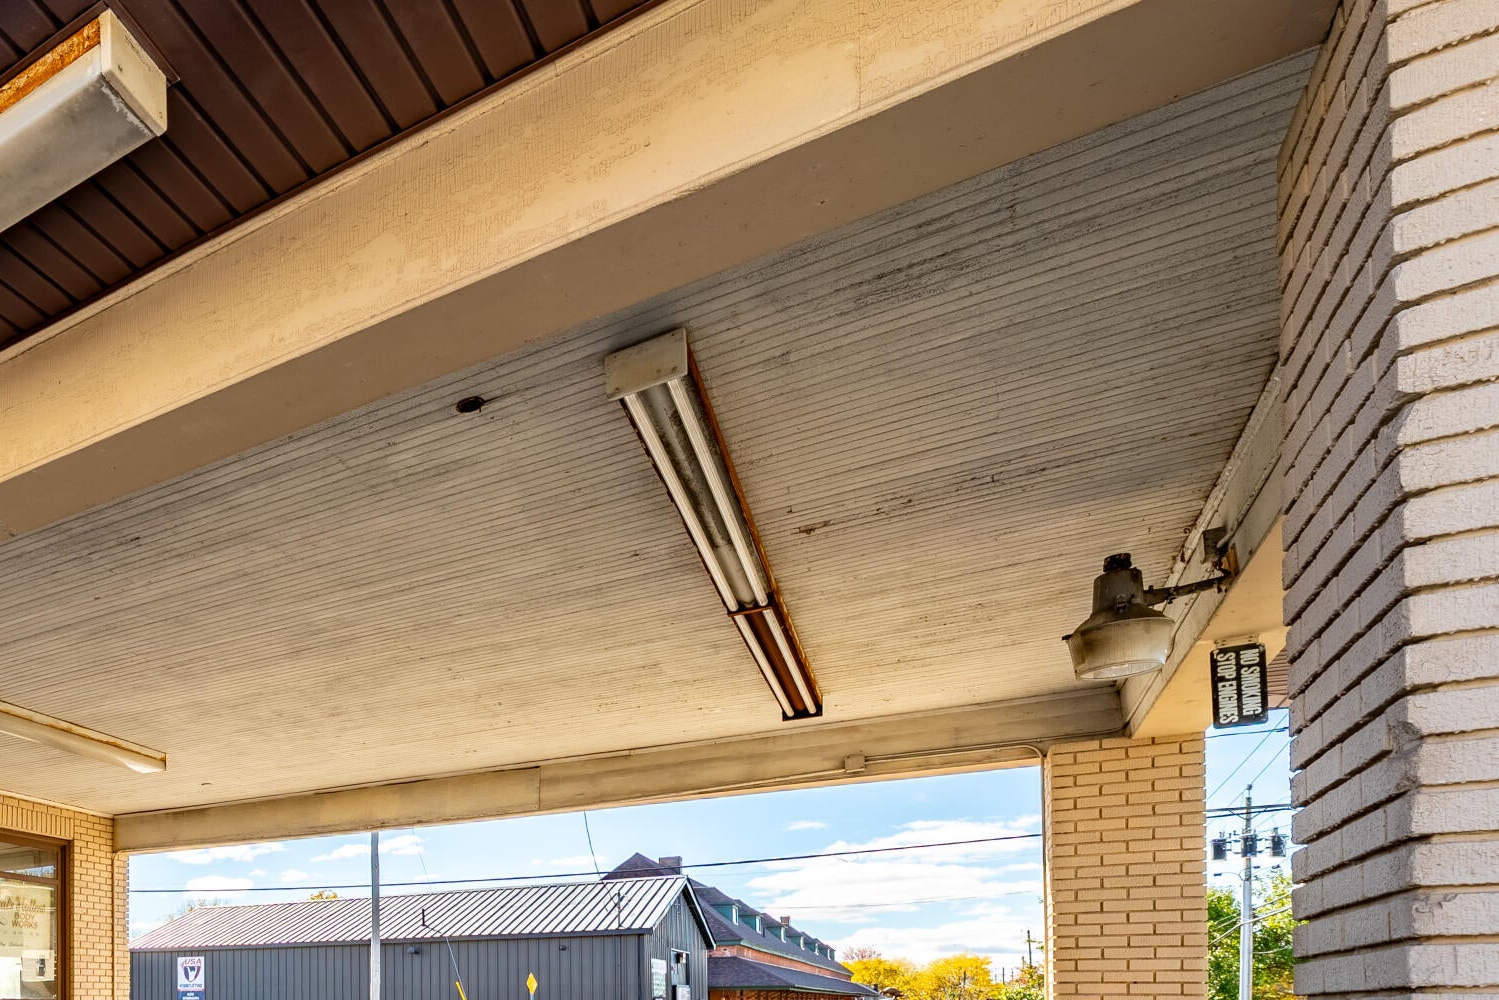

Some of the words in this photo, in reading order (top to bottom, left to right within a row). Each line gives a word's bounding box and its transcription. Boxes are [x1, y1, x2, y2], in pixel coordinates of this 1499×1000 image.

[1216, 652, 1237, 680] STOP
[1240, 649, 1260, 665] NO
[1217, 680, 1239, 724] ENGINES
[1241, 666, 1262, 716] SMOKING
[12, 920, 38, 929] WORKS
[14, 912, 35, 920] BODY
